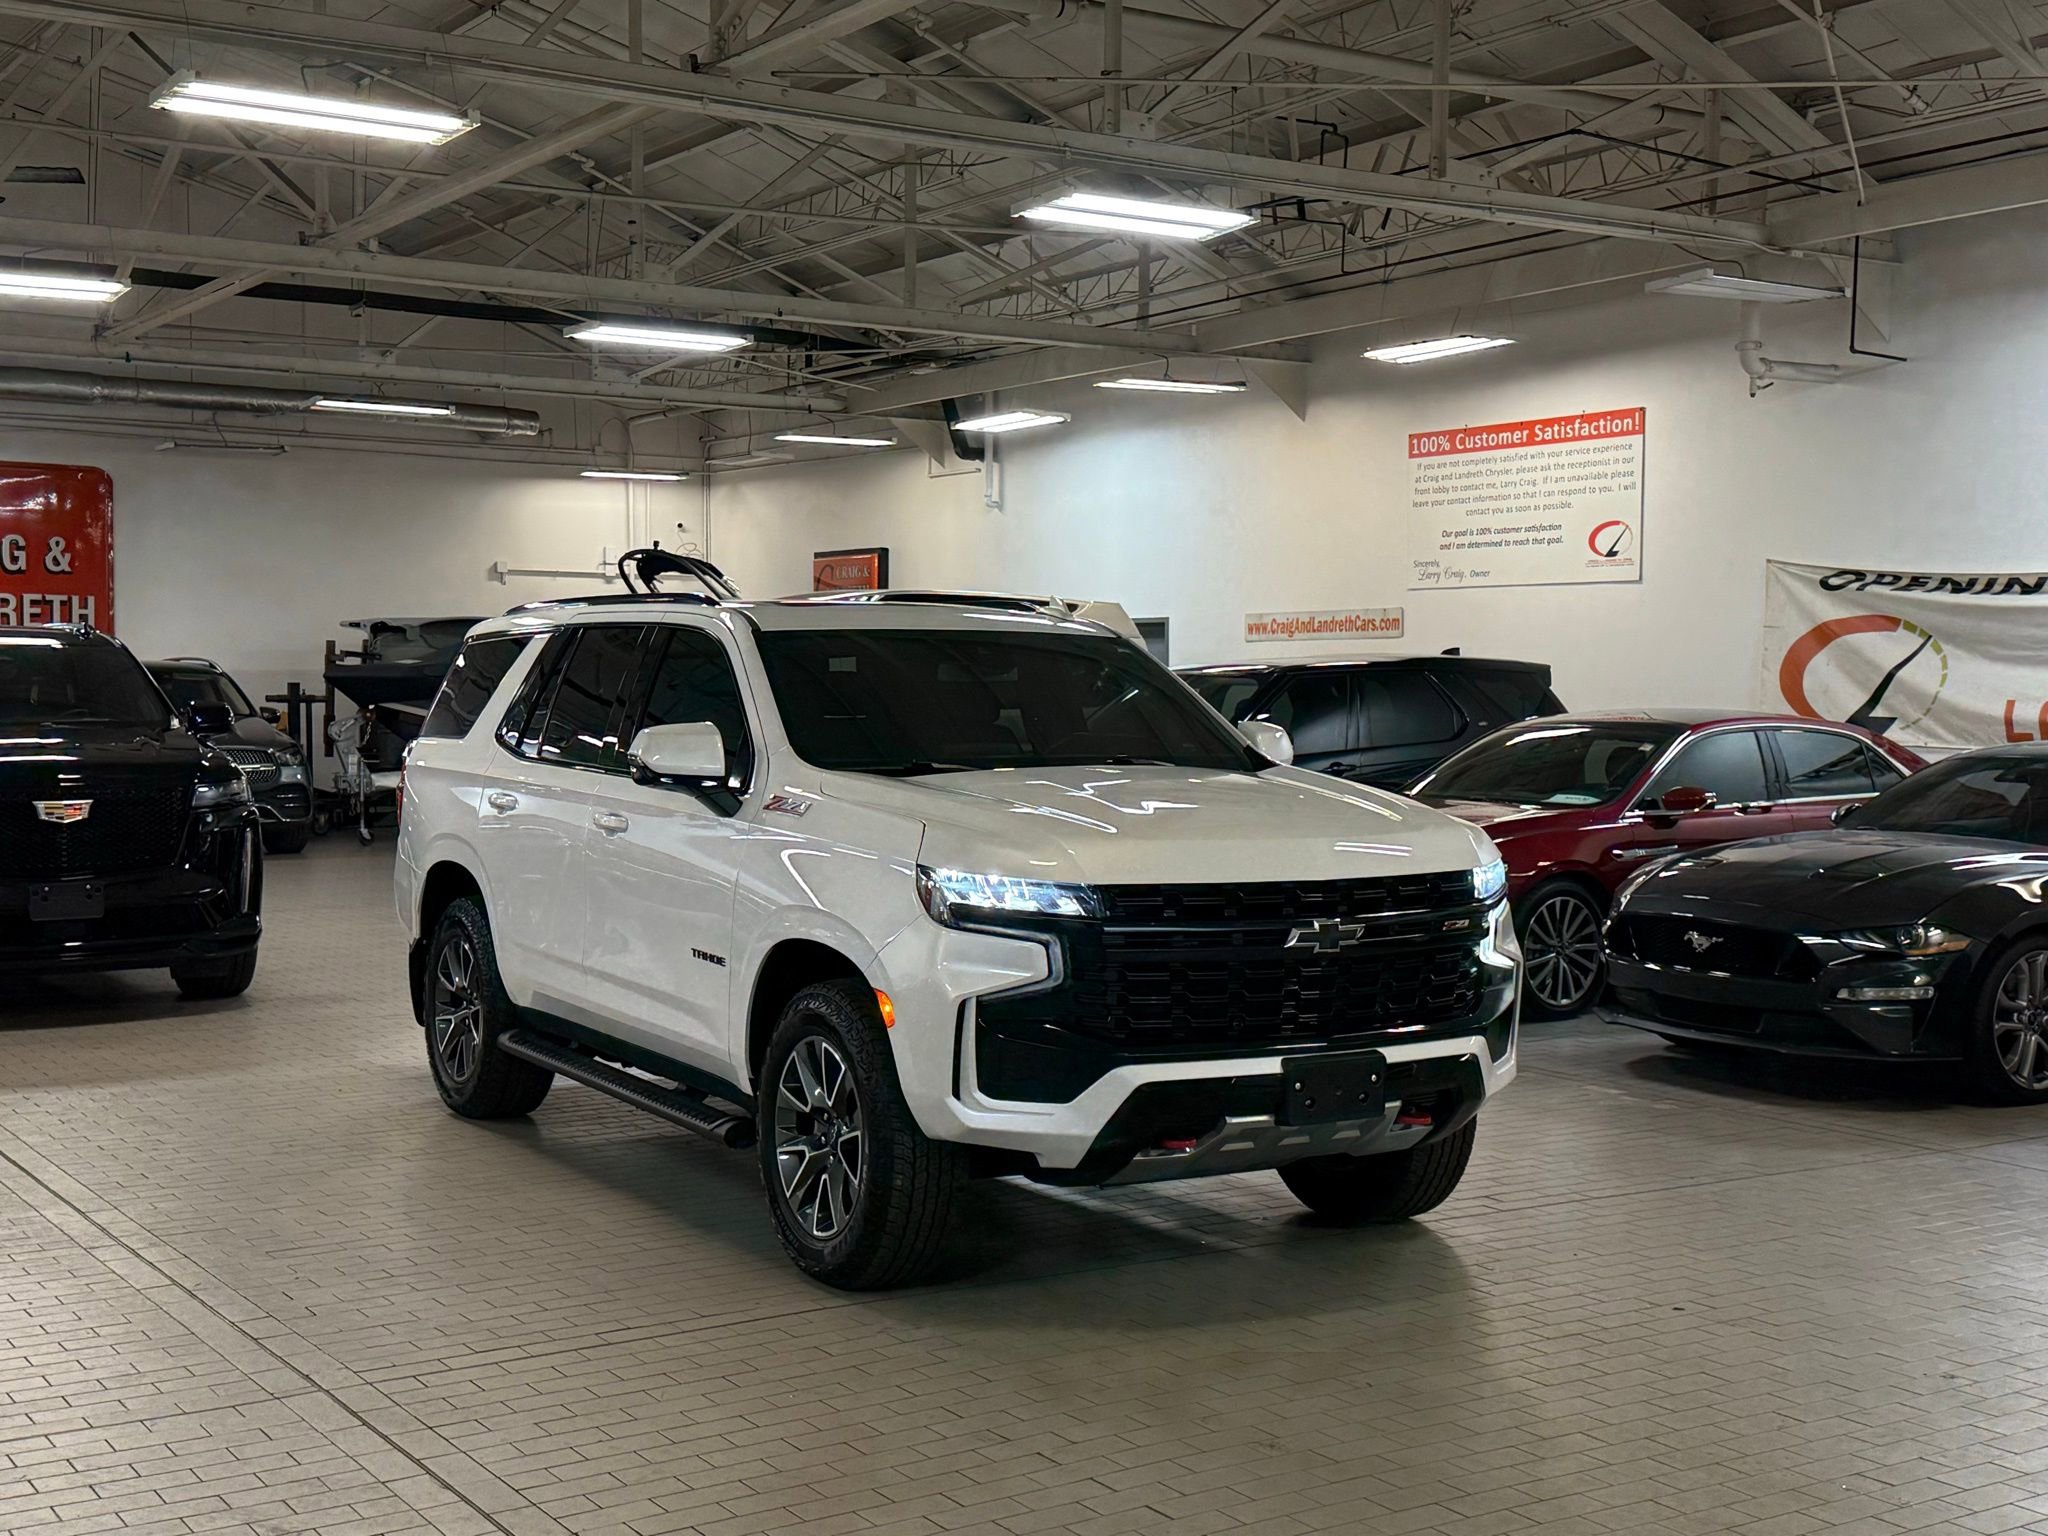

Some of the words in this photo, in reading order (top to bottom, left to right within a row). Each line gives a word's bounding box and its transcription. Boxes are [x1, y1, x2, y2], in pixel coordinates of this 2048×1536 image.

[1411, 434, 1451, 454] 100%
[1455, 430, 1529, 449] Customer
[1534, 412, 1639, 441] Satisfaction!
[1417, 463, 1422, 471] If
[1424, 463, 1435, 472] you
[1449, 460, 1460, 468] not
[1461, 456, 1498, 468] completely
[1499, 452, 1528, 463] satisfied
[1530, 451, 1545, 460] with
[1547, 450, 1563, 460] your
[1565, 447, 1590, 457] service
[1592, 443, 1633, 455] experience
[1423, 475, 1439, 484] Craig
[1441, 472, 1453, 481] and
[1454, 469, 1484, 480] Landreth
[1485, 467, 1513, 478] Chrysler,
[1516, 464, 1538, 475] please
[1540, 463, 1551, 472] ask
[1553, 461, 1566, 471] the
[1567, 458, 1611, 471] receptionist
[1613, 457, 1620, 465] in
[1622, 456, 1635, 465] our
[1414, 487, 1431, 496] front
[1432, 486, 1450, 496] lobby
[1451, 485, 1459, 493] to
[1460, 482, 1484, 492] contact
[1500, 480, 1517, 490] Larry
[1519, 478, 1538, 488] Craig.
[1542, 477, 1548, 485] If
[1554, 476, 1566, 484] am
[1567, 471, 1609, 483] unavailable
[1611, 470, 1635, 481] please
[1412, 500, 1429, 508] leave
[1431, 499, 1445, 508] your
[1447, 496, 1471, 505] contact
[1472, 493, 1511, 503] information
[1513, 492, 1521, 500] so
[1523, 491, 1537, 500] that
[1543, 489, 1556, 498] can
[1557, 486, 1587, 497] respond
[1588, 486, 1597, 494] to
[1598, 485, 1614, 495] you.
[1623, 482, 1637, 491] will
[1466, 508, 1490, 517] contact
[1491, 507, 1504, 516] you
[1515, 504, 1532, 513] soon
[1542, 500, 1574, 512] possible.
[1441, 530, 1453, 538] Our
[1454, 528, 1469, 539] goal
[1469, 529, 1474, 537] is
[1475, 527, 1493, 536] 100%
[1493, 525, 1522, 535] customer
[1523, 523, 1562, 535] satisfaction
[45, 536, 72, 572] &
[1439, 542, 1451, 551] and
[1456, 542, 1466, 550] am
[1467, 539, 1503, 550] determined
[1504, 539, 1511, 547] to
[1512, 537, 1530, 547] reach
[1531, 536, 1545, 546] that
[1546, 535, 1564, 547] goal.
[863, 565, 870, 577] &
[1418, 569, 1441, 584] Larry
[1469, 569, 1490, 578] Owner
[1247, 614, 1400, 637] www.CraigAndLandrethCars.com
[690, 947, 726, 967] TAHOE
